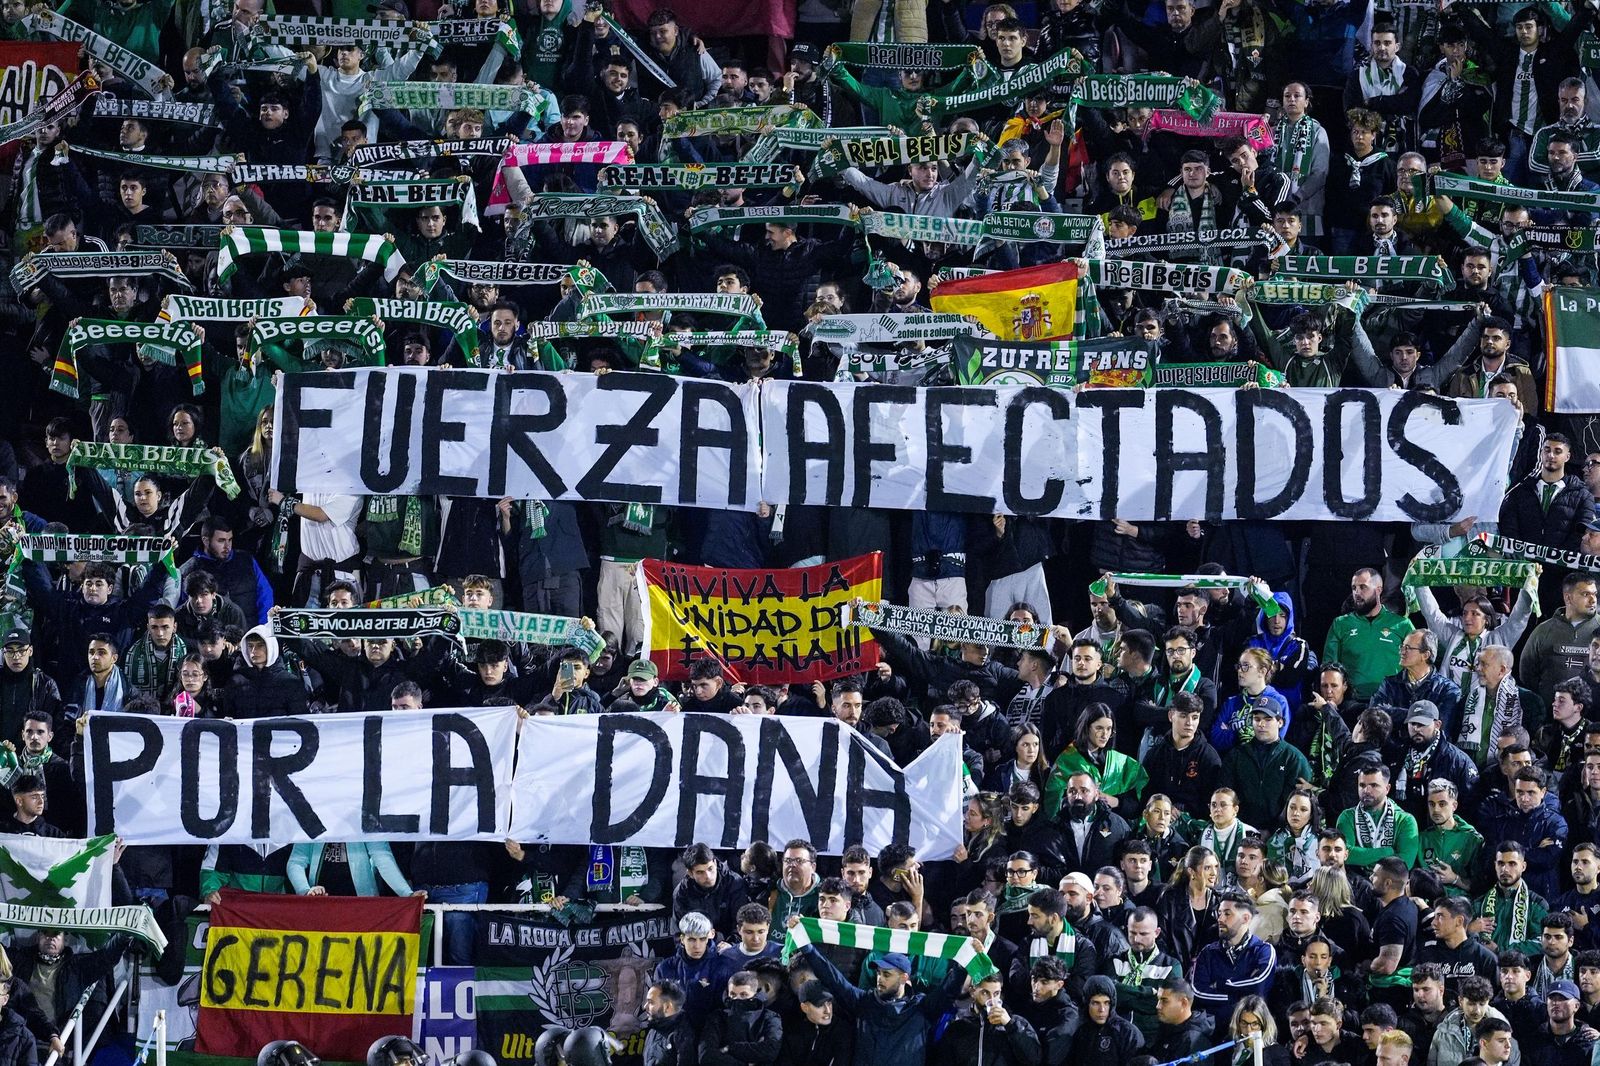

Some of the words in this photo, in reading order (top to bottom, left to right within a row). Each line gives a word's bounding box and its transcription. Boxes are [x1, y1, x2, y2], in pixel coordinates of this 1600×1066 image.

[439, 20, 499, 37] BETIS
[61, 17, 102, 53] REAL
[102, 40, 152, 81] BETIS
[868, 45, 900, 65] Real
[902, 46, 943, 67] Betis
[847, 137, 900, 165] REAL
[906, 131, 963, 160] BETIS
[231, 164, 308, 184] ULTRAS
[606, 166, 677, 187] REAL
[715, 164, 796, 187] BETIS
[1500, 187, 1534, 200] Betis
[749, 206, 780, 217] Betis
[1063, 218, 1091, 227] ANTONIO
[1354, 256, 1442, 277] BETIS
[1560, 295, 1578, 313] La
[983, 347, 1072, 368] ZUFRE
[1083, 350, 1148, 371] FANS
[1050, 374, 1072, 384] 1907
[143, 445, 220, 465] BETIS
[281, 370, 748, 505] FUERZA
[786, 383, 1464, 525] AFECTADOS
[21, 537, 32, 550] AY
[74, 537, 105, 552] QUEDO
[106, 538, 172, 552] CONTIGO
[800, 564, 850, 603] LA
[886, 618, 931, 634] NUESTRA
[934, 624, 970, 640] BONITA
[972, 630, 1009, 644] CIUDAD
[935, 615, 1005, 633] CUSTODIANDO
[89, 715, 327, 840] POR
[361, 713, 498, 836] LA
[590, 714, 912, 857] DANA
[7, 904, 54, 923] BETIS
[489, 922, 515, 946] LA
[519, 925, 571, 948] RODA
[576, 928, 603, 947] DE
[206, 934, 407, 1015] GERENA
